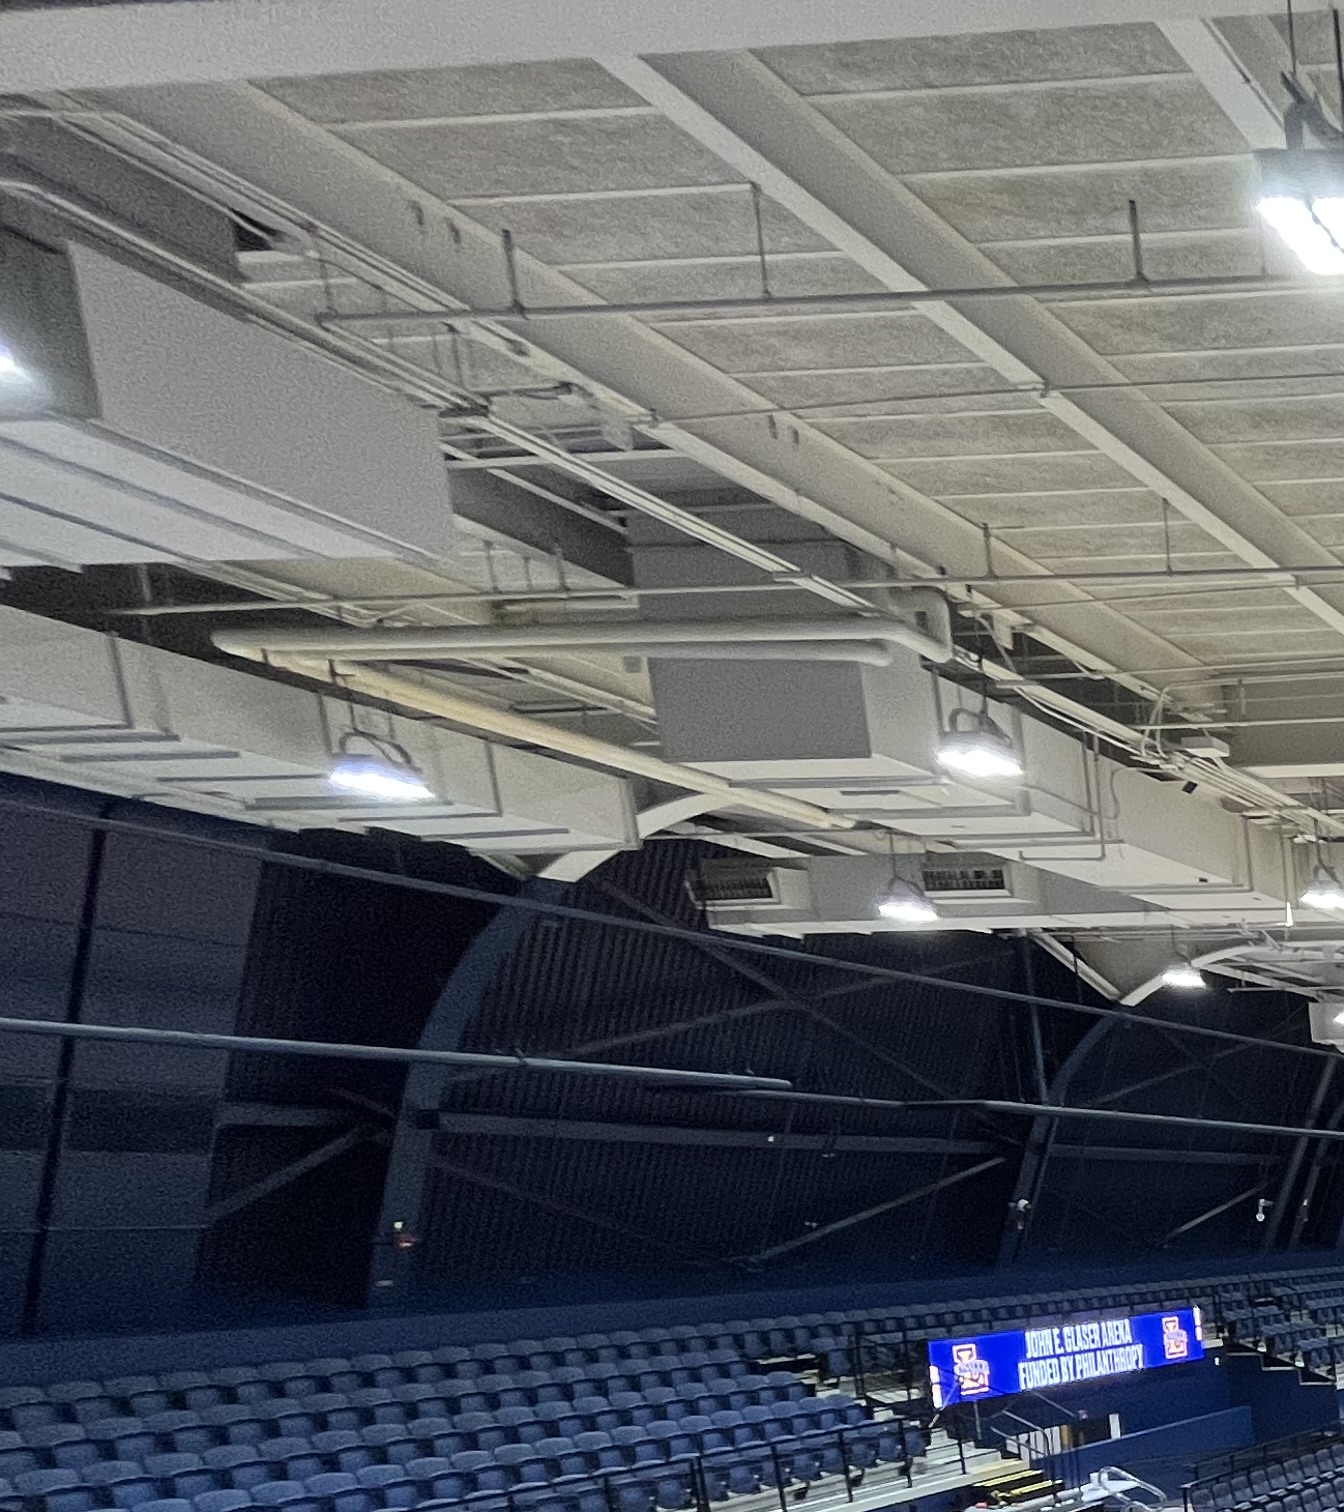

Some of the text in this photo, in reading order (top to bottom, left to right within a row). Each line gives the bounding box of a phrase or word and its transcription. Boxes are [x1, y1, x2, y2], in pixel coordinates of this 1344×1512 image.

[1025, 1318, 1133, 1359] JOHN E. GLASER ARENA
[1018, 1358, 1060, 1390] FUNDED
[1059, 1355, 1075, 1384] BY
[1075, 1343, 1143, 1380] PHILANTHROPY
